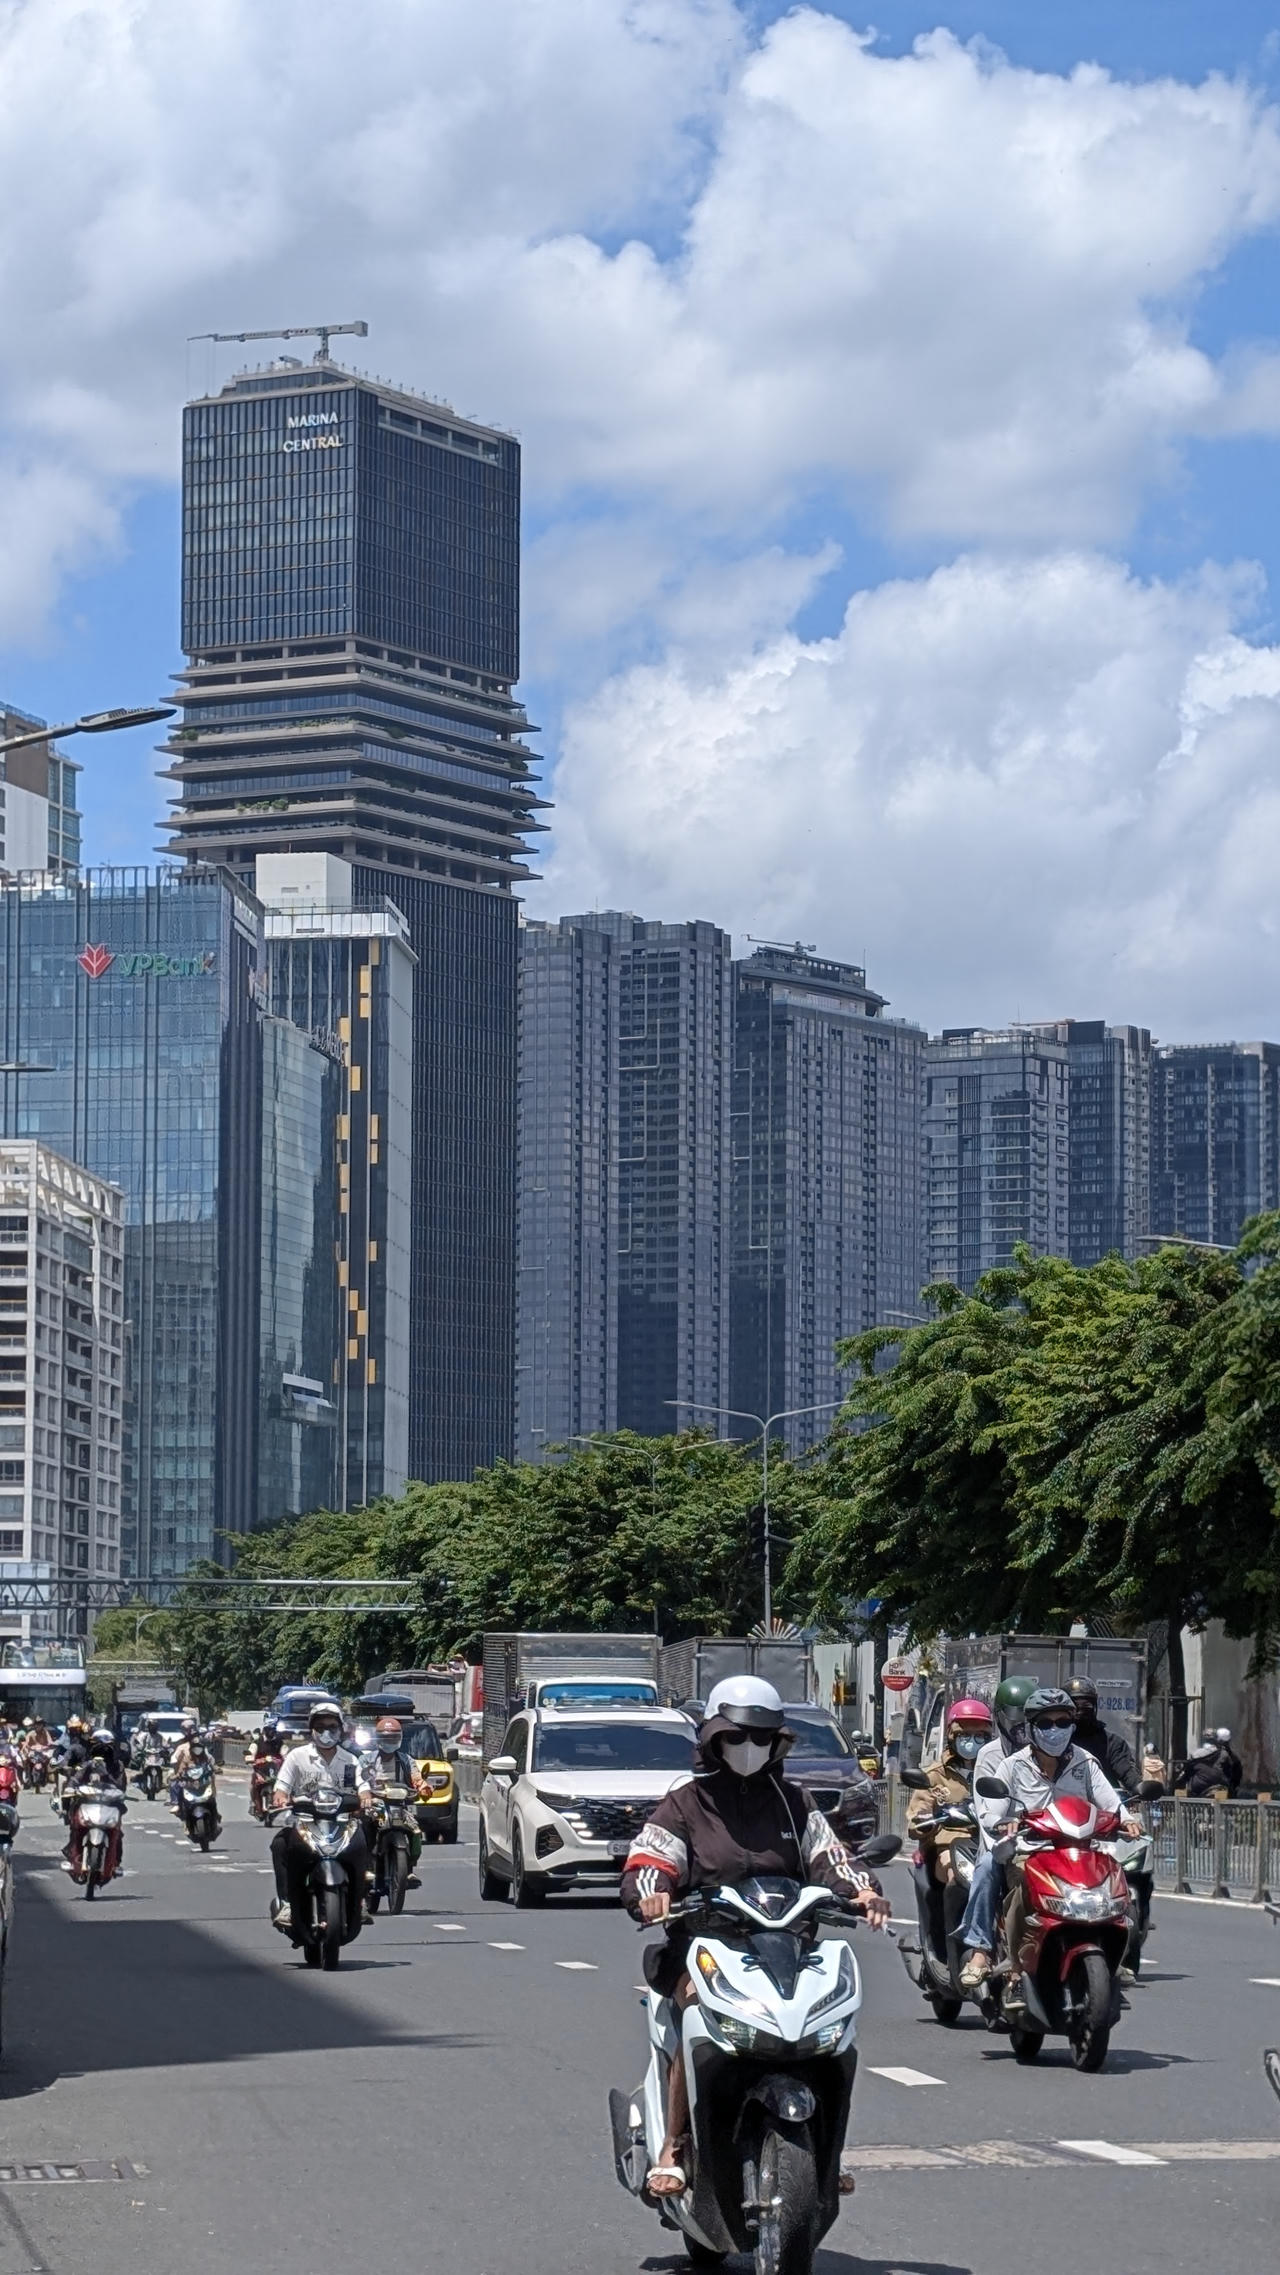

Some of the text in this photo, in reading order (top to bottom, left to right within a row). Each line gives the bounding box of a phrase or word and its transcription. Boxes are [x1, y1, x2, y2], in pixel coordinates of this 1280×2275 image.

[287, 411, 339, 428] MARINA
[283, 435, 342, 453] CENTRAL
[118, 952, 216, 976] VPBank
